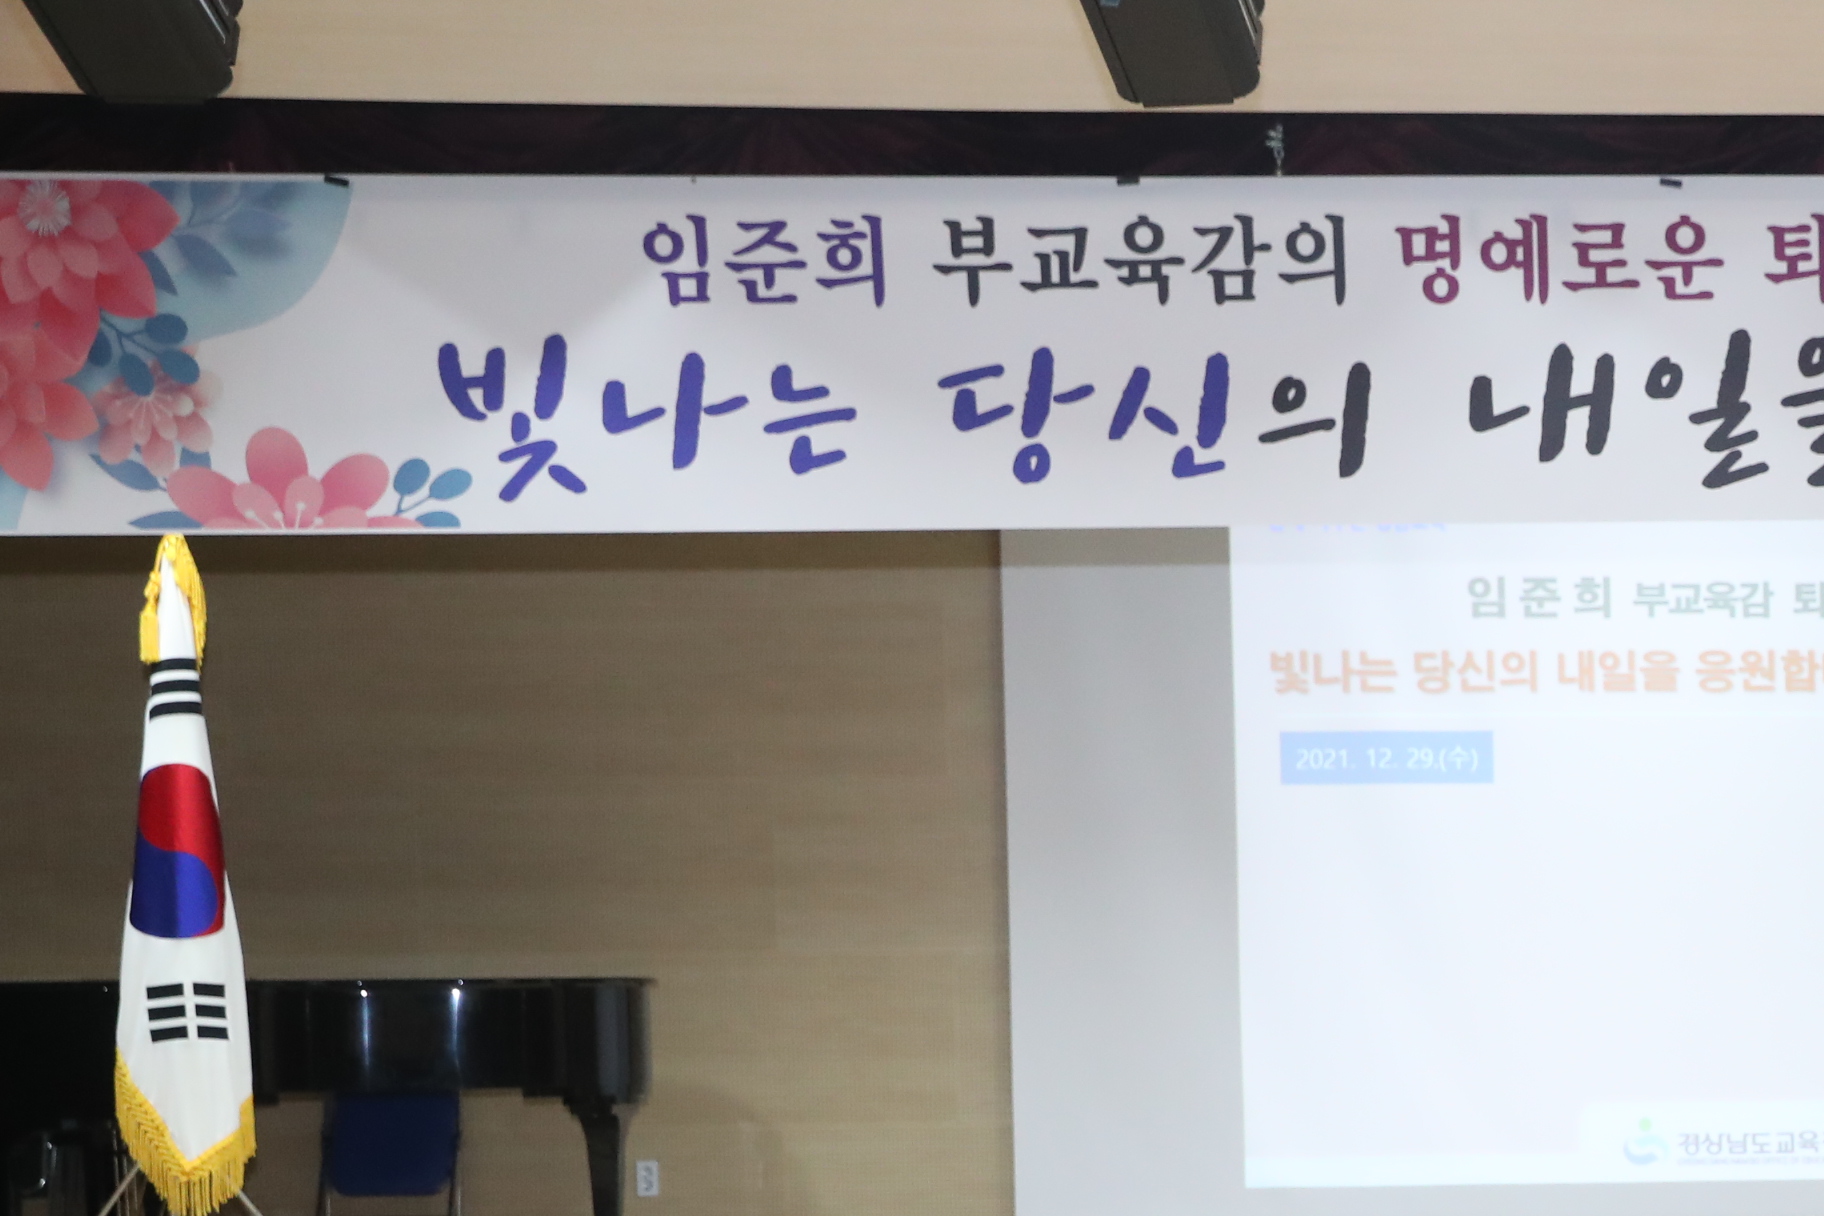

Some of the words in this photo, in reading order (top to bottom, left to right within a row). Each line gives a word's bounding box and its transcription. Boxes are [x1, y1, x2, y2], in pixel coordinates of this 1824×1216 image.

[643, 214, 885, 307] 임준희
[933, 214, 1346, 307] 부교육감의
[1395, 213, 1724, 304] 명예로운
[438, 333, 857, 502] 빛나는
[937, 346, 1371, 484] 당신의
[1633, 581, 1775, 619] 부교육감
[1270, 650, 1397, 694] 빛나는
[1413, 650, 1538, 694] 당신의
[1558, 650, 1680, 692] 내일을
